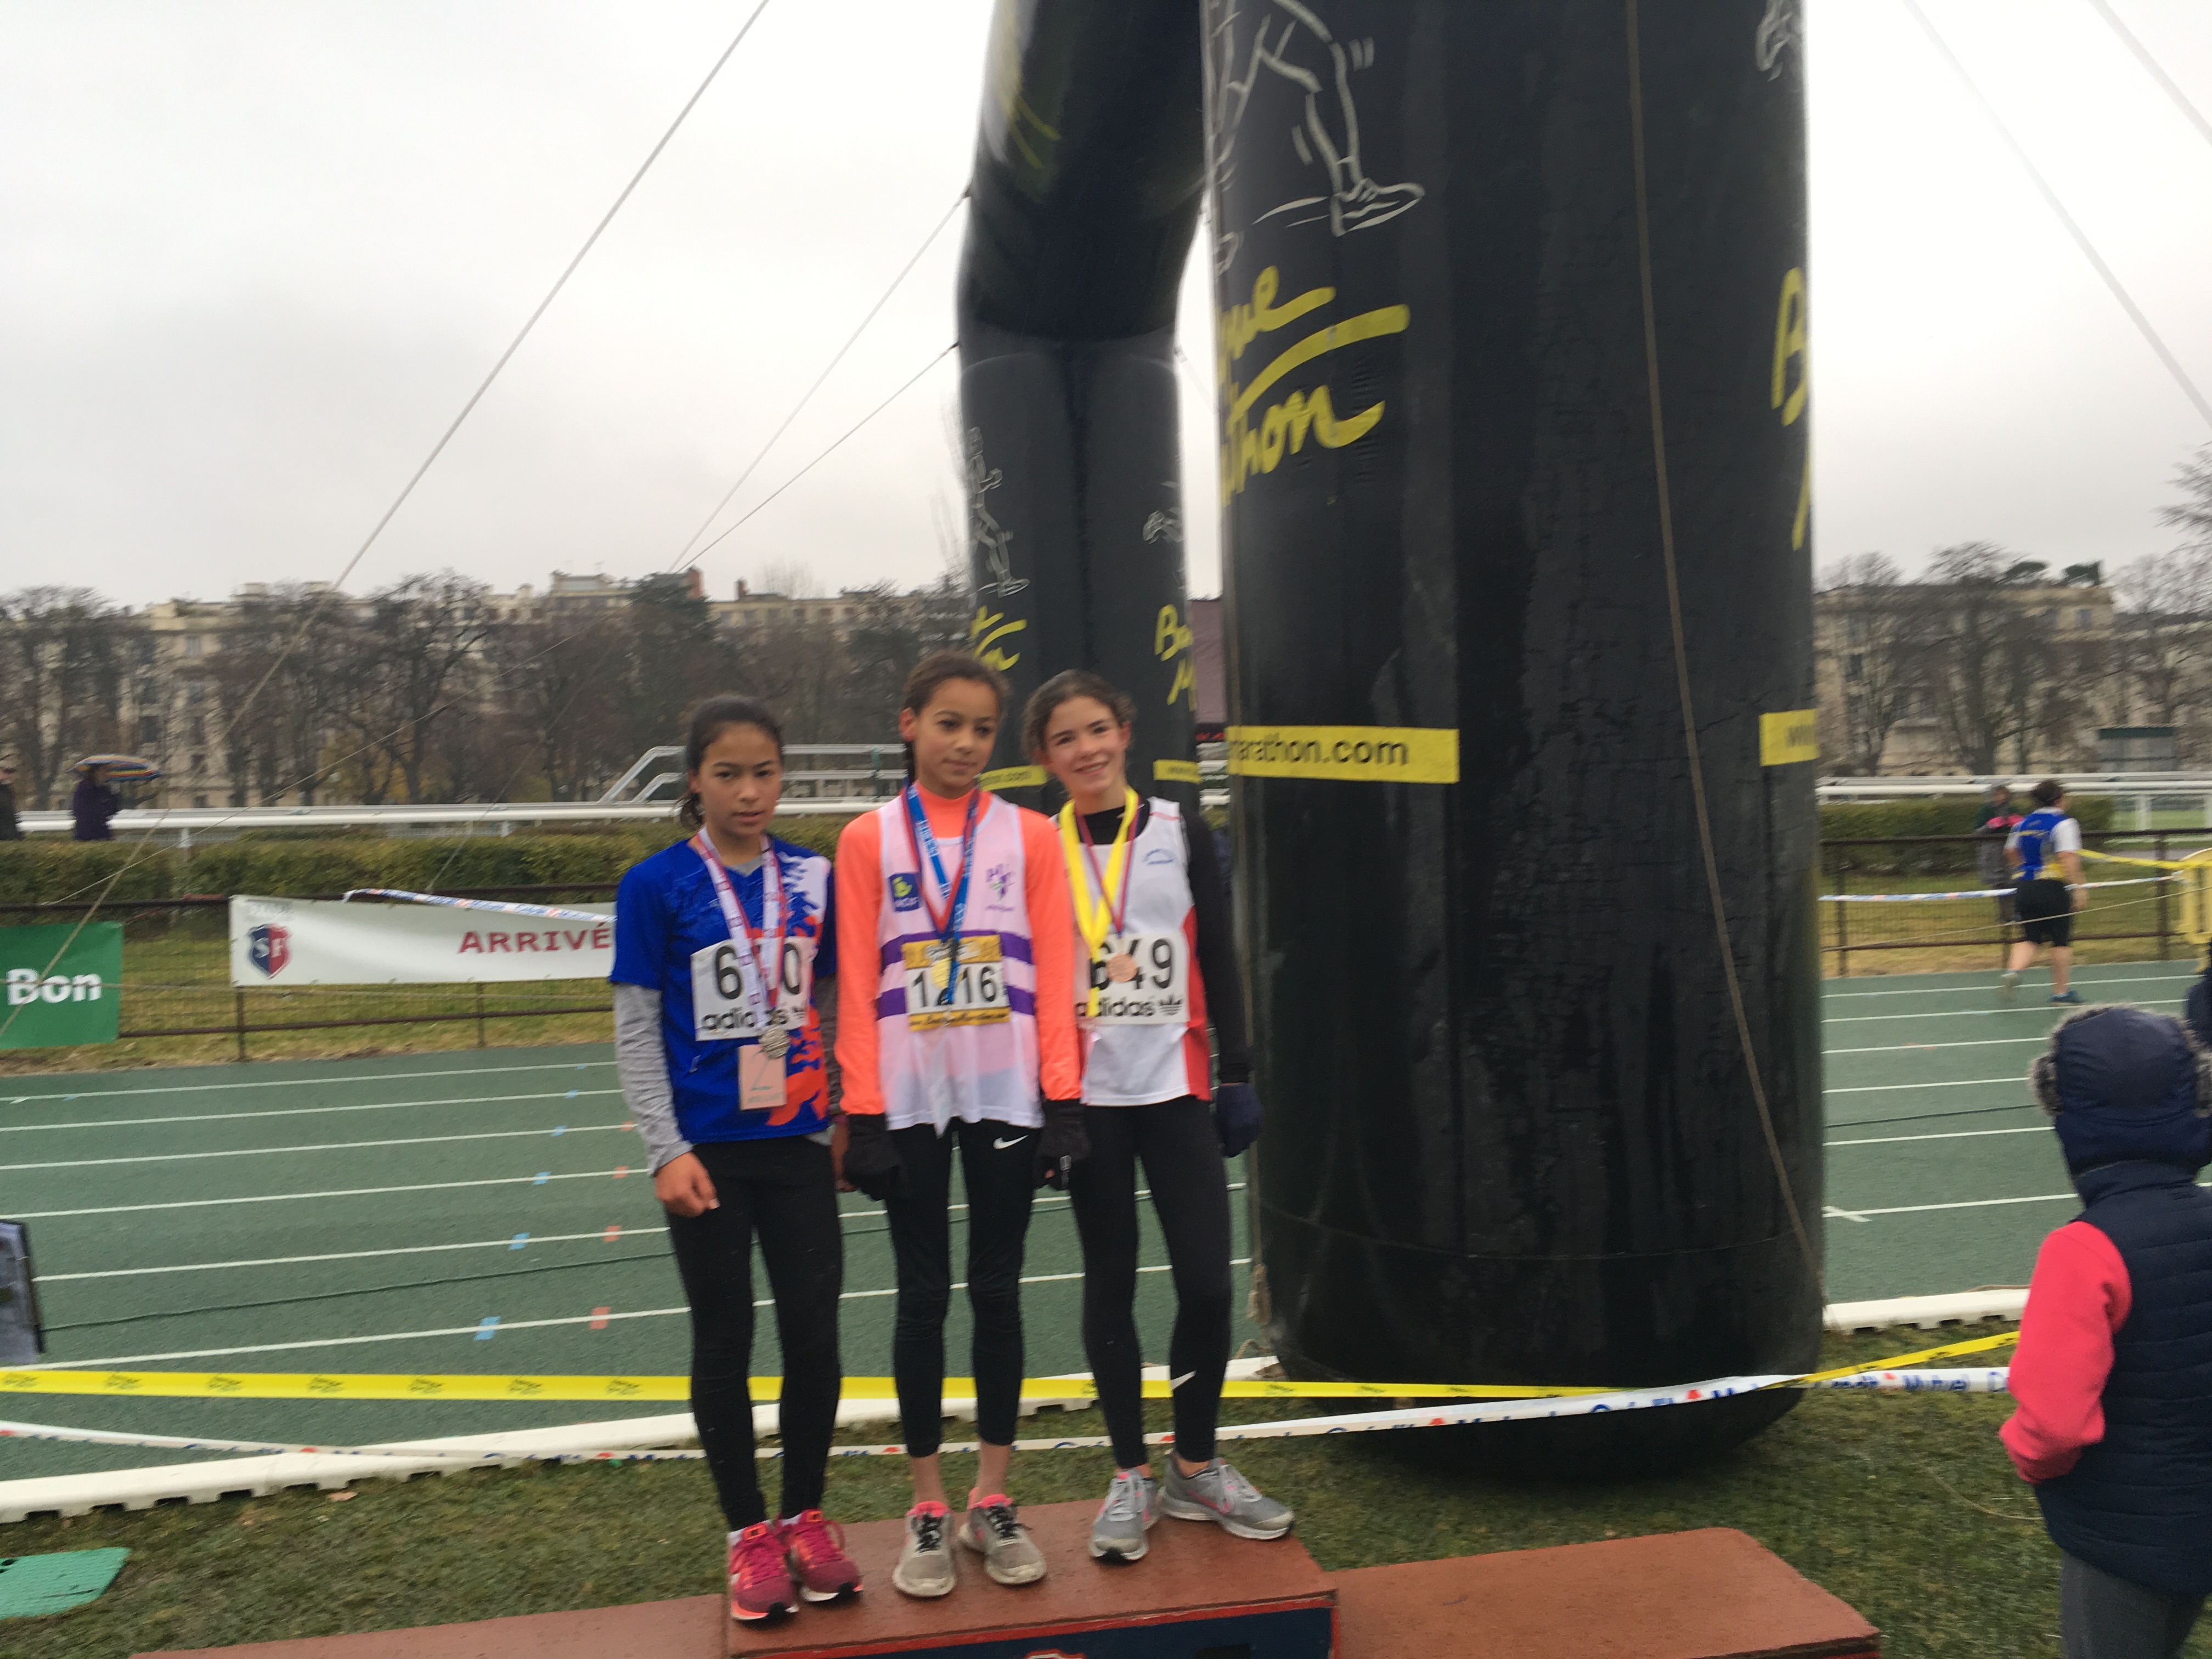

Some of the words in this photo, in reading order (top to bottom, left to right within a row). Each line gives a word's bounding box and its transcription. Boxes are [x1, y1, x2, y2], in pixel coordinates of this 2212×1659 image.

[456, 922, 613, 953] ARRIVÉ
[7, 968, 102, 1006] Bon
[715, 945, 800, 1000] 60
